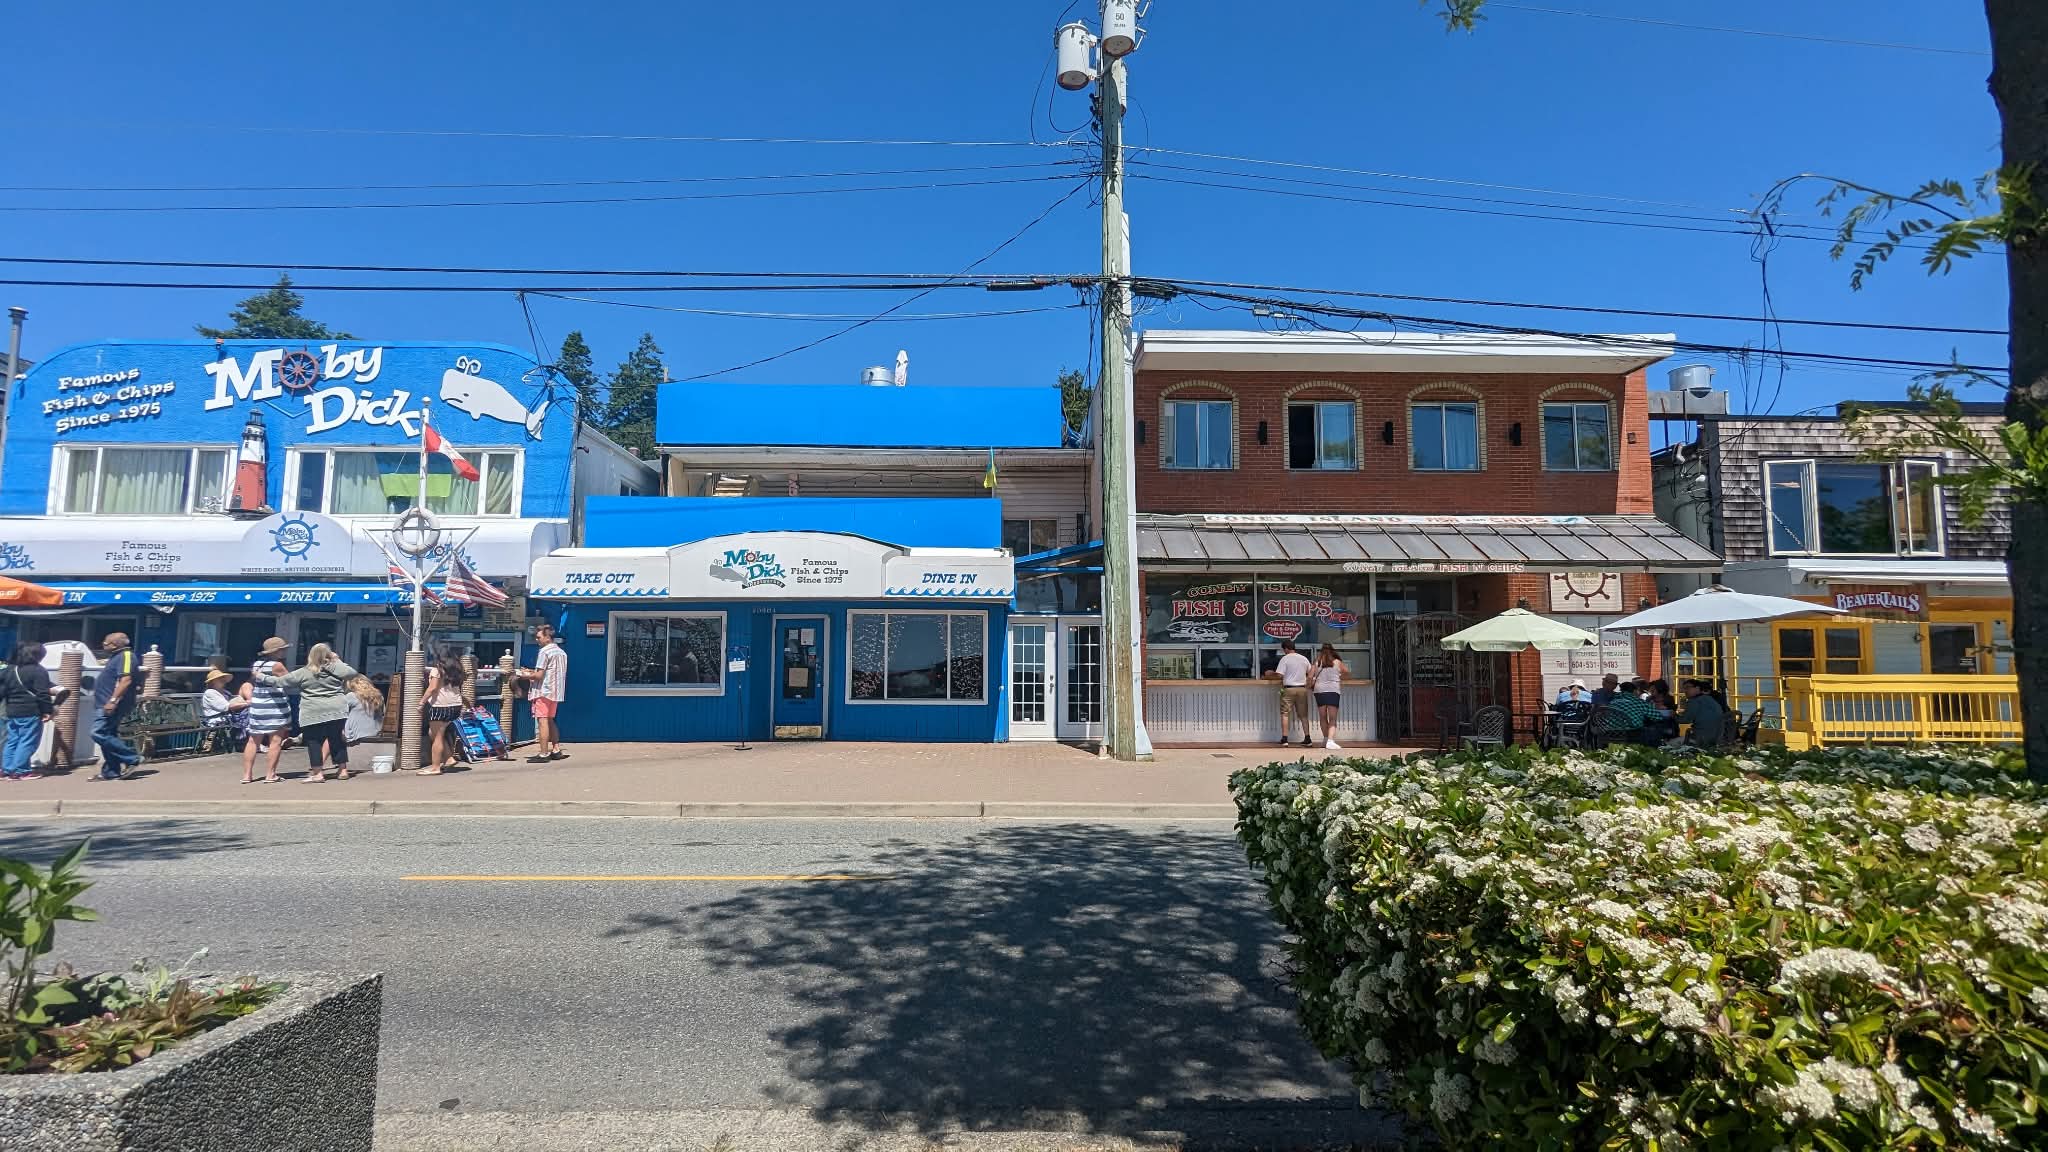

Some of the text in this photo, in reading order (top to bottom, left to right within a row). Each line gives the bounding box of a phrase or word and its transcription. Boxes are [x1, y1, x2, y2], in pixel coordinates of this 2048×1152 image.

[1115, 12, 1125, 20] 50
[58, 368, 140, 391] Famous
[42, 381, 176, 414] Fish & Chips
[55, 401, 161, 433] Since 1975
[304, 386, 420, 437] Dick
[122, 541, 167, 549] Famous
[105, 552, 181, 564] Fish & Chips
[112, 563, 172, 573] Since 1975
[747, 564, 786, 580] Dick
[823, 568, 849, 577] Chips
[1440, 562, 1468, 573] FISH
[1487, 562, 1525, 573] CHIPS
[565, 573, 635, 583] TAKE OUT
[922, 573, 978, 584] DINE IN
[151, 591, 216, 602] Since 1975
[279, 591, 335, 602] DINE IN
[1187, 584, 1331, 598] CONEY ISLAND
[69, 592, 86, 602] IN
[1171, 599, 1333, 621] FISH & CHIPS
[1328, 611, 1358, 623] OPEN
